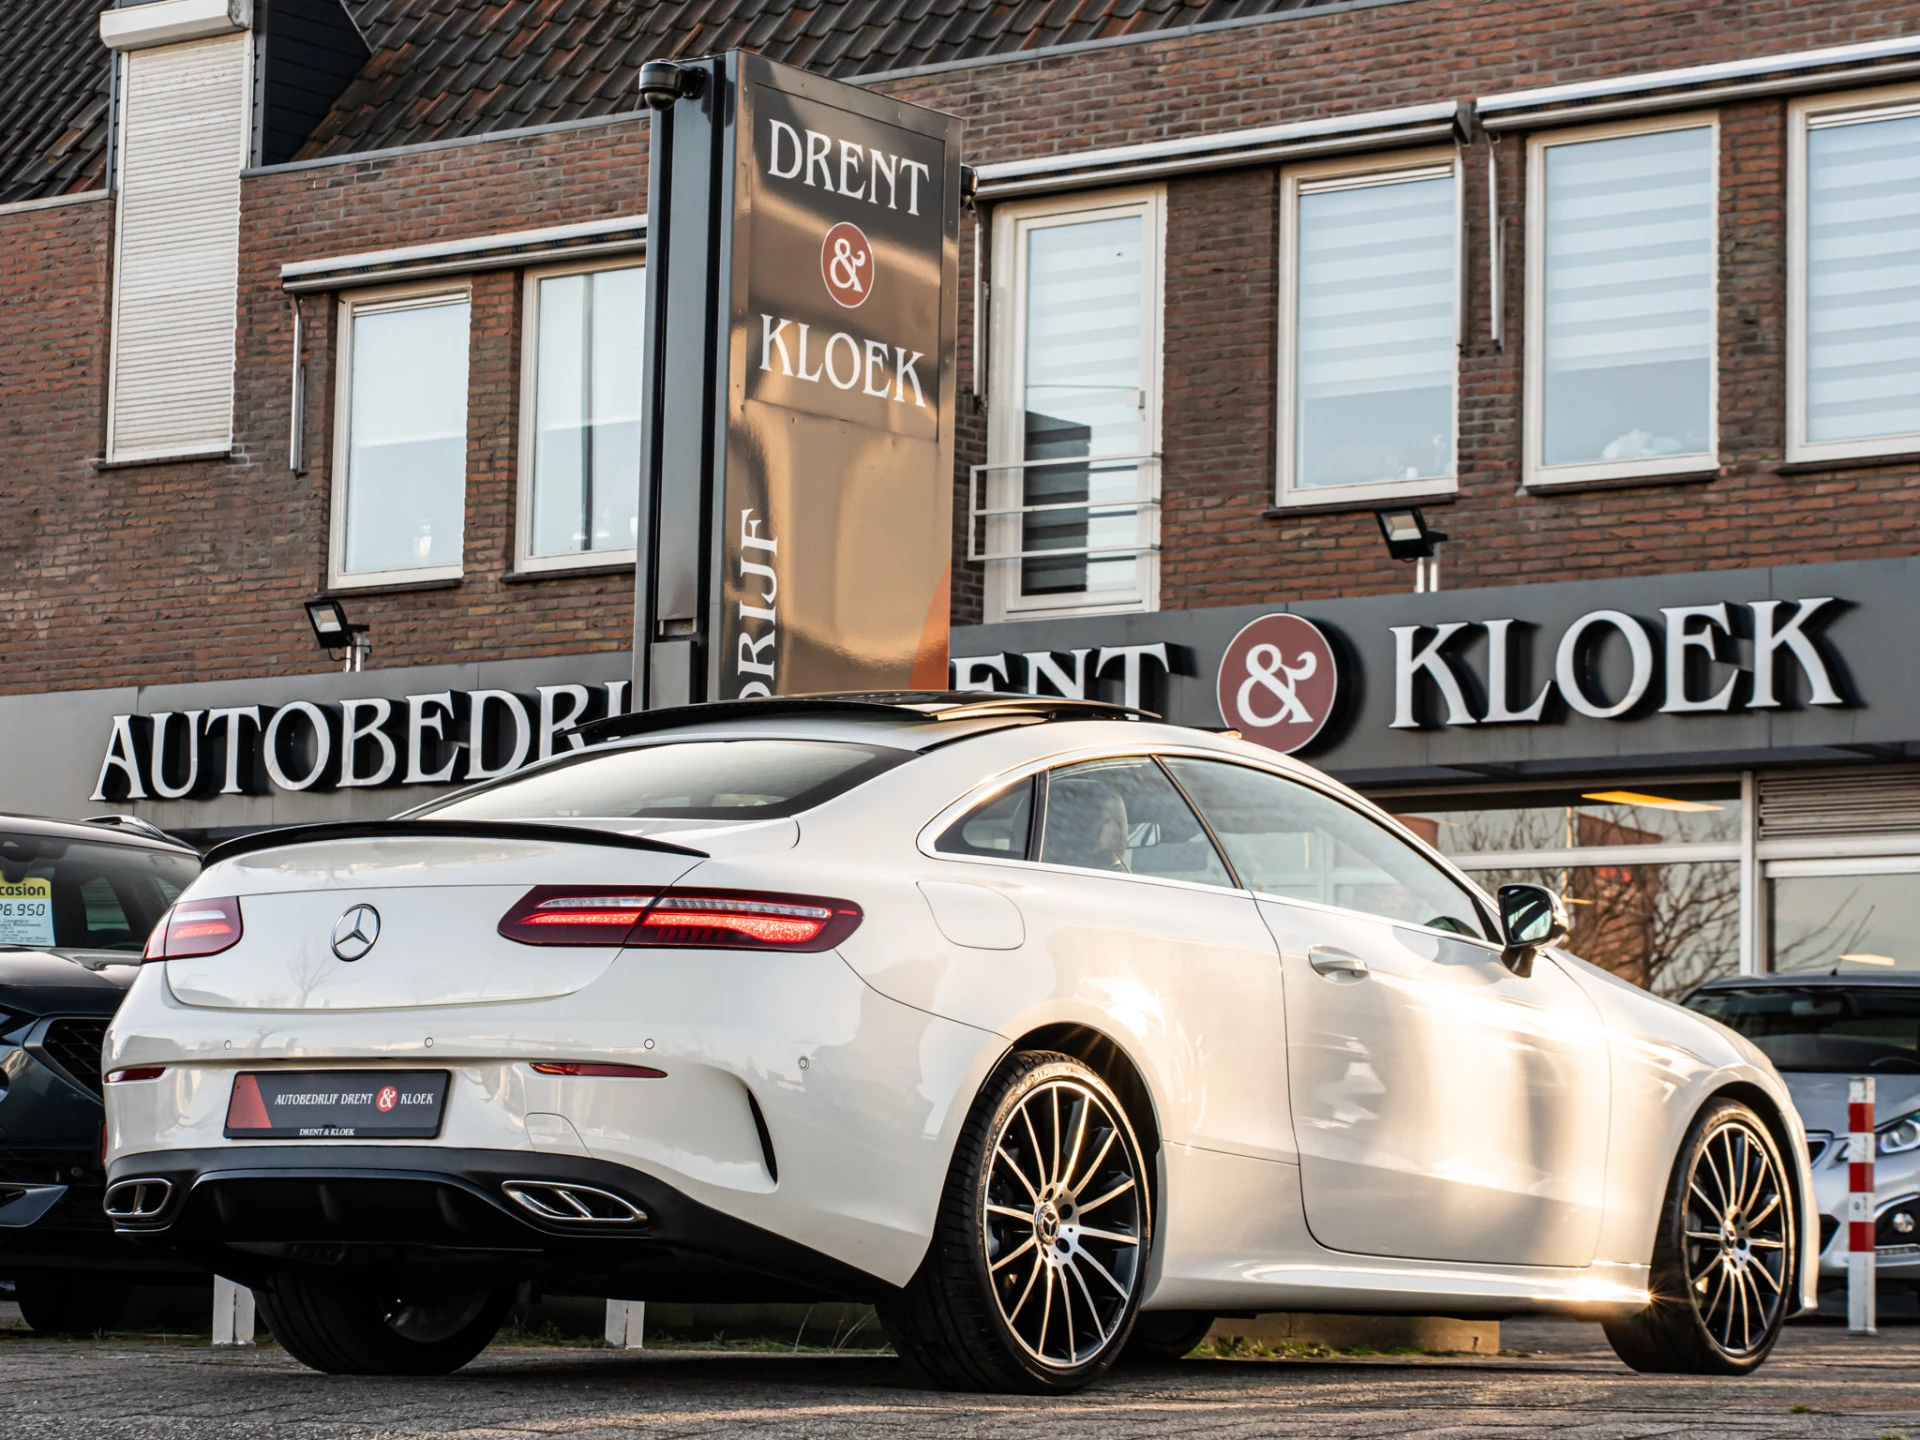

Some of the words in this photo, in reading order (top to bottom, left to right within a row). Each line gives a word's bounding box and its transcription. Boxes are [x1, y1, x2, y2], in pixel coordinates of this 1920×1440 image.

[767, 119, 930, 216] DRENT
[830, 238, 866, 293] &
[759, 313, 926, 408] KLOEK
[89, 680, 629, 800] AUTOBEDRI
[1236, 643, 1318, 728] &
[1388, 596, 1843, 729] KLOEK
[0, 883, 46, 896] casion
[275, 1093, 339, 1105] AUTOBEDRIJF
[340, 1093, 374, 1105] DRENT
[379, 1088, 395, 1108] &
[400, 1092, 434, 1105] KLOEK
[299, 1128, 323, 1136] DRENT
[330, 1128, 355, 1136] KLOEK
